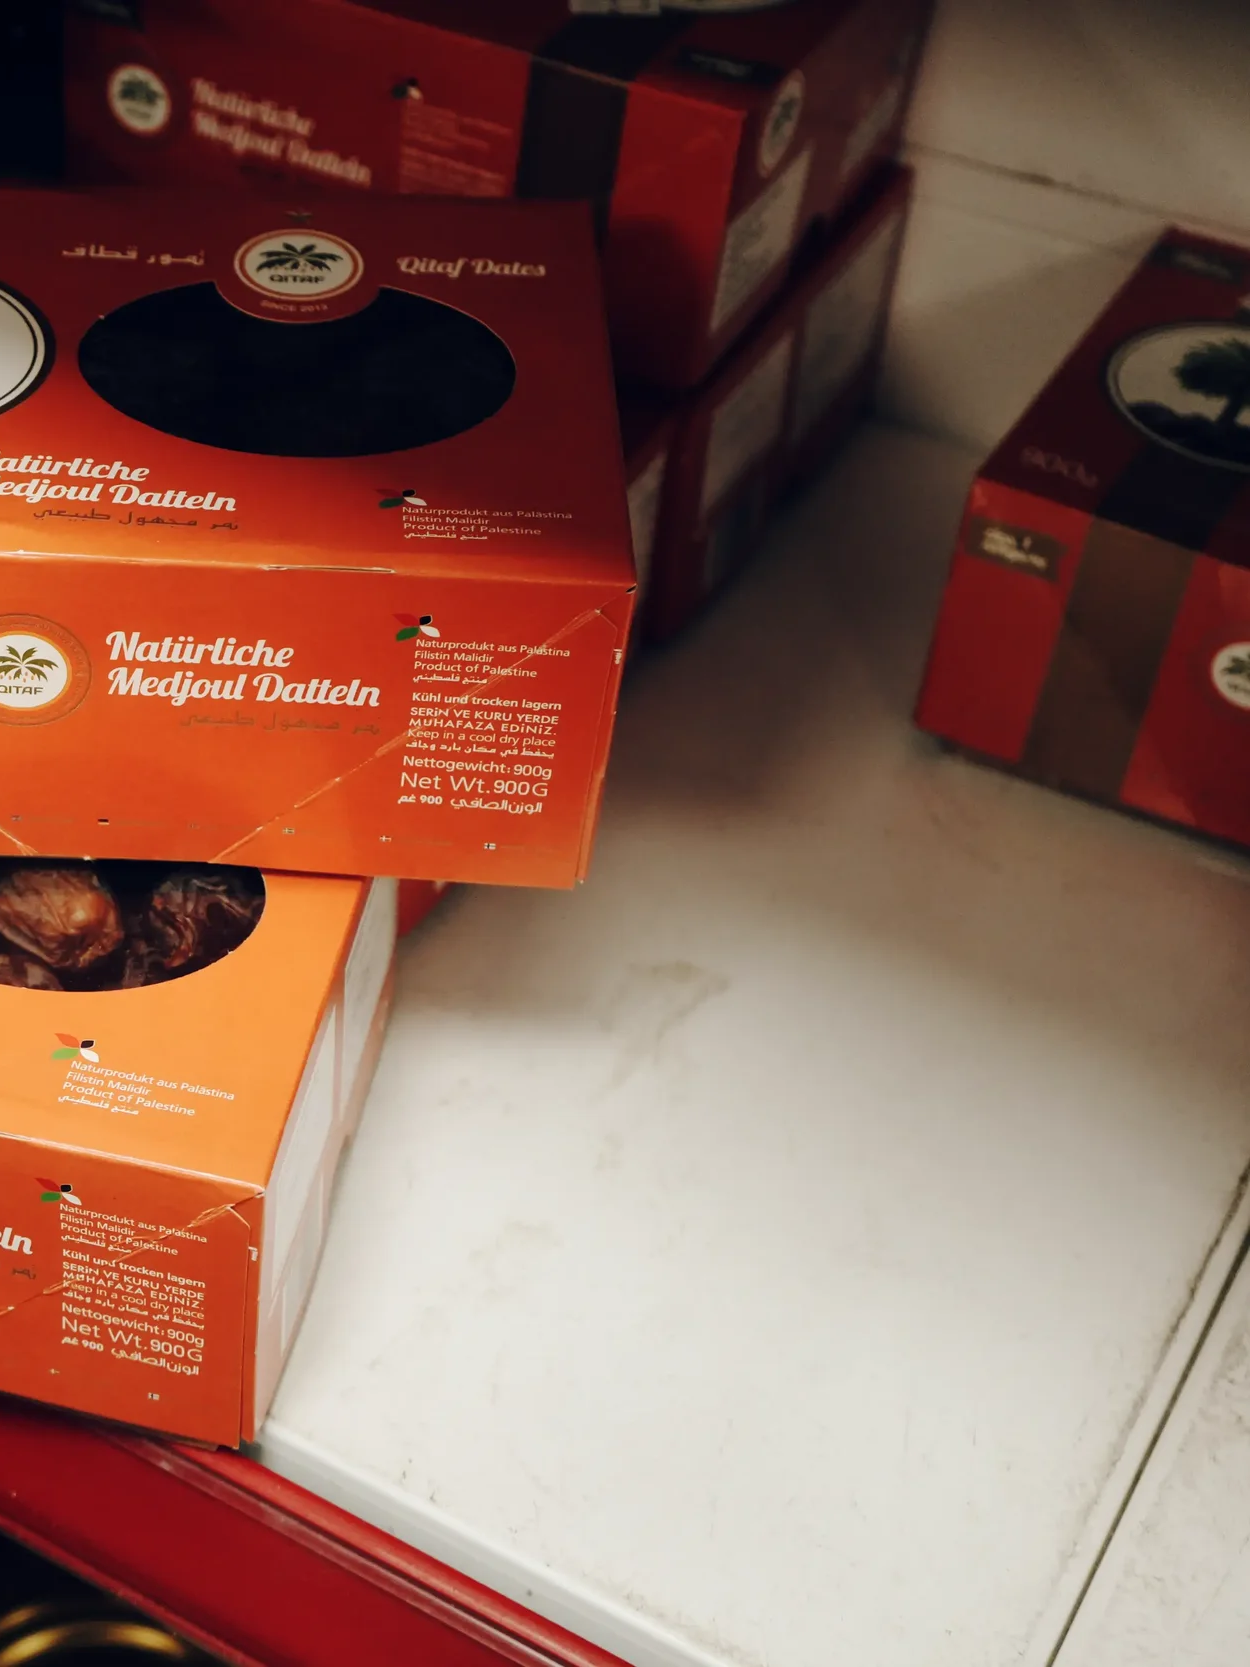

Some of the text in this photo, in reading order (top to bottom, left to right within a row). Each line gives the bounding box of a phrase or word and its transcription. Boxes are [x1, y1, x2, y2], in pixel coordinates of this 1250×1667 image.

[395, 256, 547, 279] Qitaf Dates
[269, 274, 325, 284] QITAF
[108, 484, 237, 512] Datteln
[32, 507, 111, 521] طبيعي
[118, 512, 198, 528] مجهول
[402, 506, 573, 520] Naturprodukt aus Palästina
[402, 515, 491, 525] Filistin Malidir
[403, 522, 542, 536] Product of Palestine
[105, 630, 295, 668] Natürliche
[414, 650, 494, 663] Filistin Malidir
[415, 638, 571, 657] Naturprodukt aus Palästina
[414, 661, 538, 678] Product of Palestine
[107, 666, 381, 707] Medjoul Datteln
[412, 673, 488, 685] منتج فلسطيني
[412, 692, 562, 711] Kühl und trocken lagern
[408, 718, 495, 732] MUHAFAZA
[453, 709, 471, 719] VE
[474, 710, 512, 722] KURU
[516, 713, 559, 725] YERDE
[405, 740, 436, 751] وجاف
[407, 729, 556, 747] Keep in a cool dry place
[439, 742, 462, 752] بارد
[464, 743, 497, 753] مكان
[499, 746, 519, 757] في
[400, 772, 442, 790] Net
[513, 764, 552, 780] 900g
[419, 795, 443, 805] 900
[66, 1071, 152, 1096] Filistin Malidir
[70, 1060, 235, 1101] Naturprodukt aus Palästina
[57, 1094, 140, 1116] منتج فلسطيني
[62, 1081, 196, 1116] Product of Palestine
[59, 1203, 135, 1227] Naturprodukt
[137, 1221, 157, 1232] aus
[59, 1213, 136, 1236] Filistin Malidir
[60, 1222, 179, 1256] Product of Palestine
[60, 1233, 106, 1248] فلسطيني
[62, 1249, 90, 1263] Kühl
[119, 1260, 164, 1279] trocken
[167, 1272, 206, 1288] lagern
[62, 1271, 145, 1295] MUHAFAZA
[103, 1270, 120, 1281] VE
[123, 1274, 160, 1291] KURU
[163, 1283, 205, 1300] YERDE
[96, 1287, 107, 1297] in
[110, 1290, 118, 1299] a
[121, 1294, 147, 1306] cool
[150, 1301, 169, 1314] dry
[172, 1306, 205, 1320] place
[118, 1304, 149, 1316] مكان
[61, 1316, 101, 1339] Net
[81, 1338, 104, 1352] 900
[167, 1328, 205, 1348] 900g
